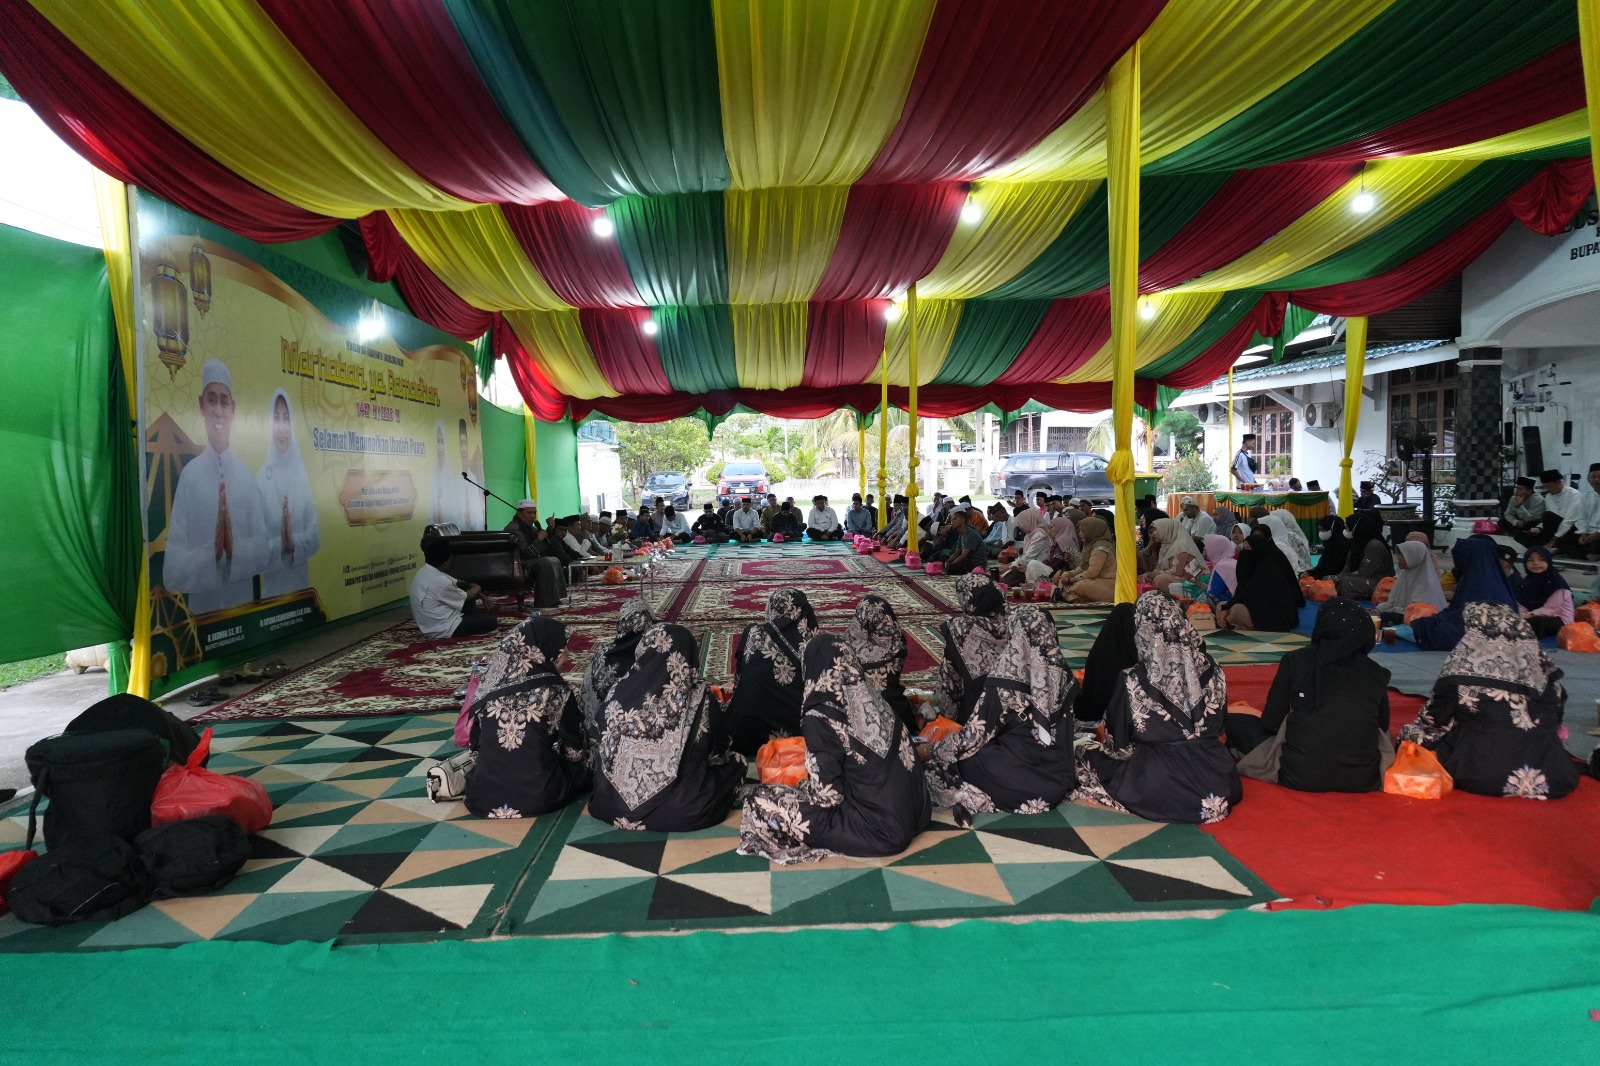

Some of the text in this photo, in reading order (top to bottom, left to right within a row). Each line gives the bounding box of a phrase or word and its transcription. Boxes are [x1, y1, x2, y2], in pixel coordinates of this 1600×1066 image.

[280, 336, 367, 390] Marhaban
[368, 369, 386, 401] ya
[388, 369, 441, 407] Ramadhan
[313, 427, 347, 451] Selamat
[347, 430, 389, 454] Menunaikan
